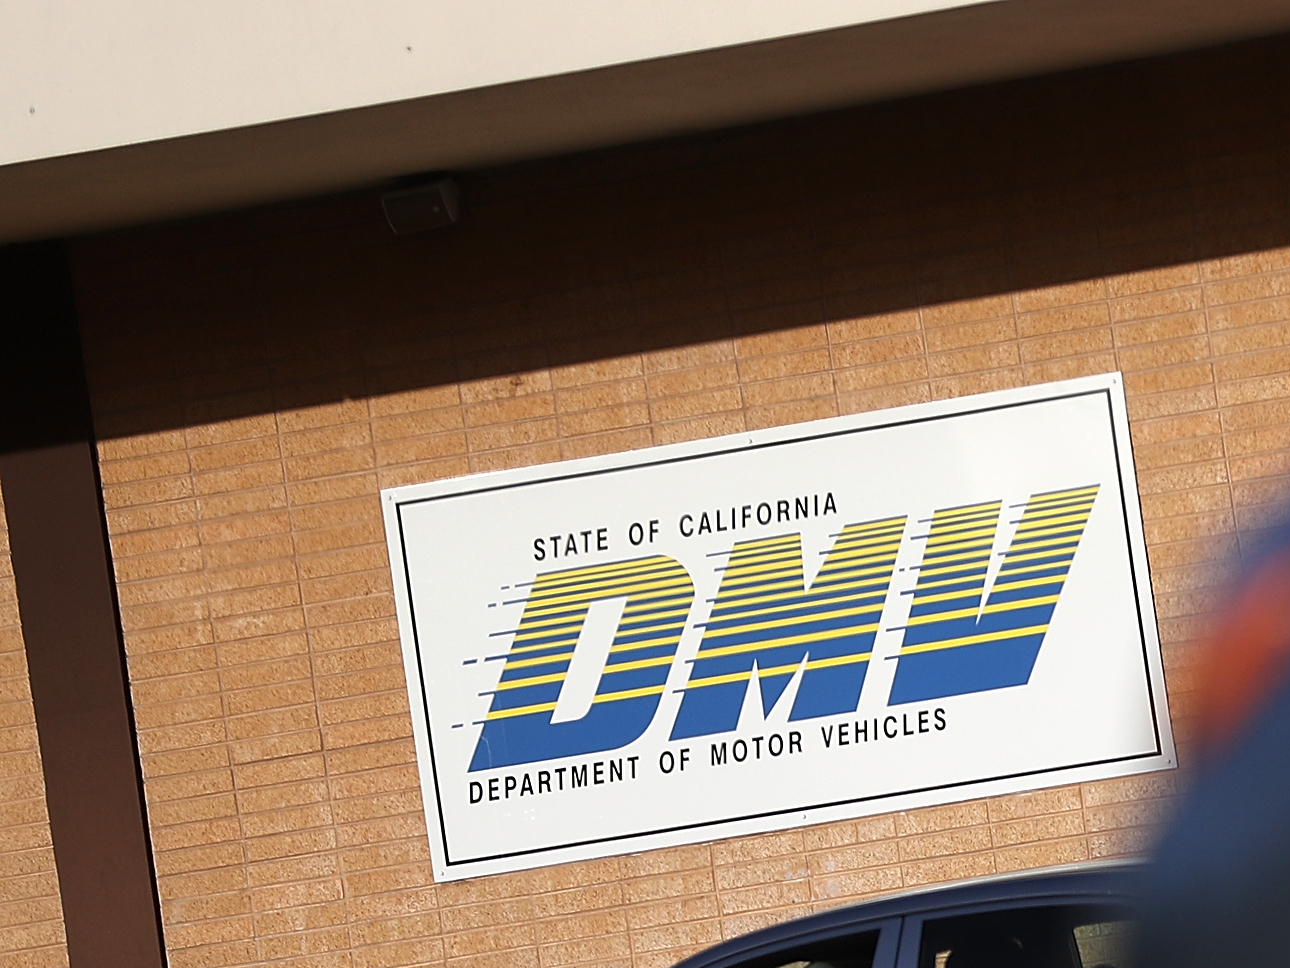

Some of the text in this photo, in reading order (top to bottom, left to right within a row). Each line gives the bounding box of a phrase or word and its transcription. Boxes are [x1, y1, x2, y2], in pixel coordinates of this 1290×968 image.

[532, 491, 838, 562] STATE OF CALIFORNIA
[463, 483, 1102, 773] DMV
[468, 707, 947, 805] DEPARTMENT OF MOTOR VEHICLES
